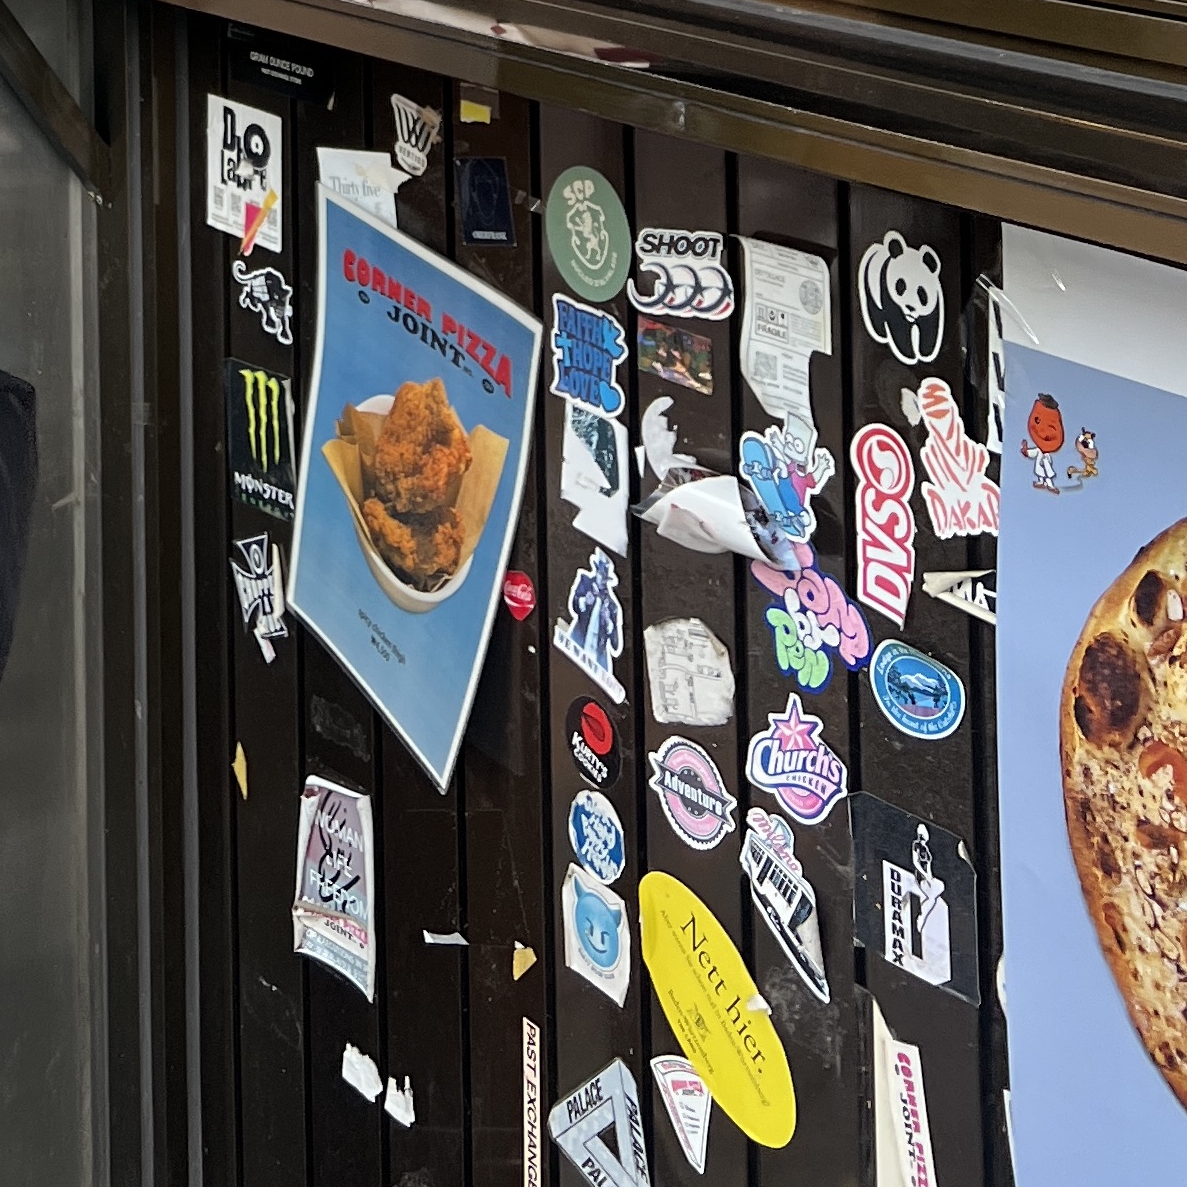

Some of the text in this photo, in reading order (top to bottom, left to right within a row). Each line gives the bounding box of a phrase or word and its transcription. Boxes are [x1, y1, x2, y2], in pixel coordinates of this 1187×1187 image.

[640, 233, 721, 258] SHOOT
[343, 249, 513, 399] CORNER PIZZA
[387, 305, 466, 368] JOINT
[557, 300, 605, 343] FAITH
[571, 341, 612, 384] HOPE
[557, 367, 602, 407] LOVE
[234, 471, 295, 509] MONSTER
[752, 737, 842, 786] Church's
[664, 771, 722, 810] Adventure
[786, 774, 827, 796] CHICKEN
[890, 868, 904, 966] DURAMAX
[680, 912, 728, 997] Nett
[725, 995, 766, 1074] hier.
[526, 1021, 537, 1077] PAST
[566, 1078, 603, 1124] PALACE
[897, 1052, 921, 1133] CORNER
